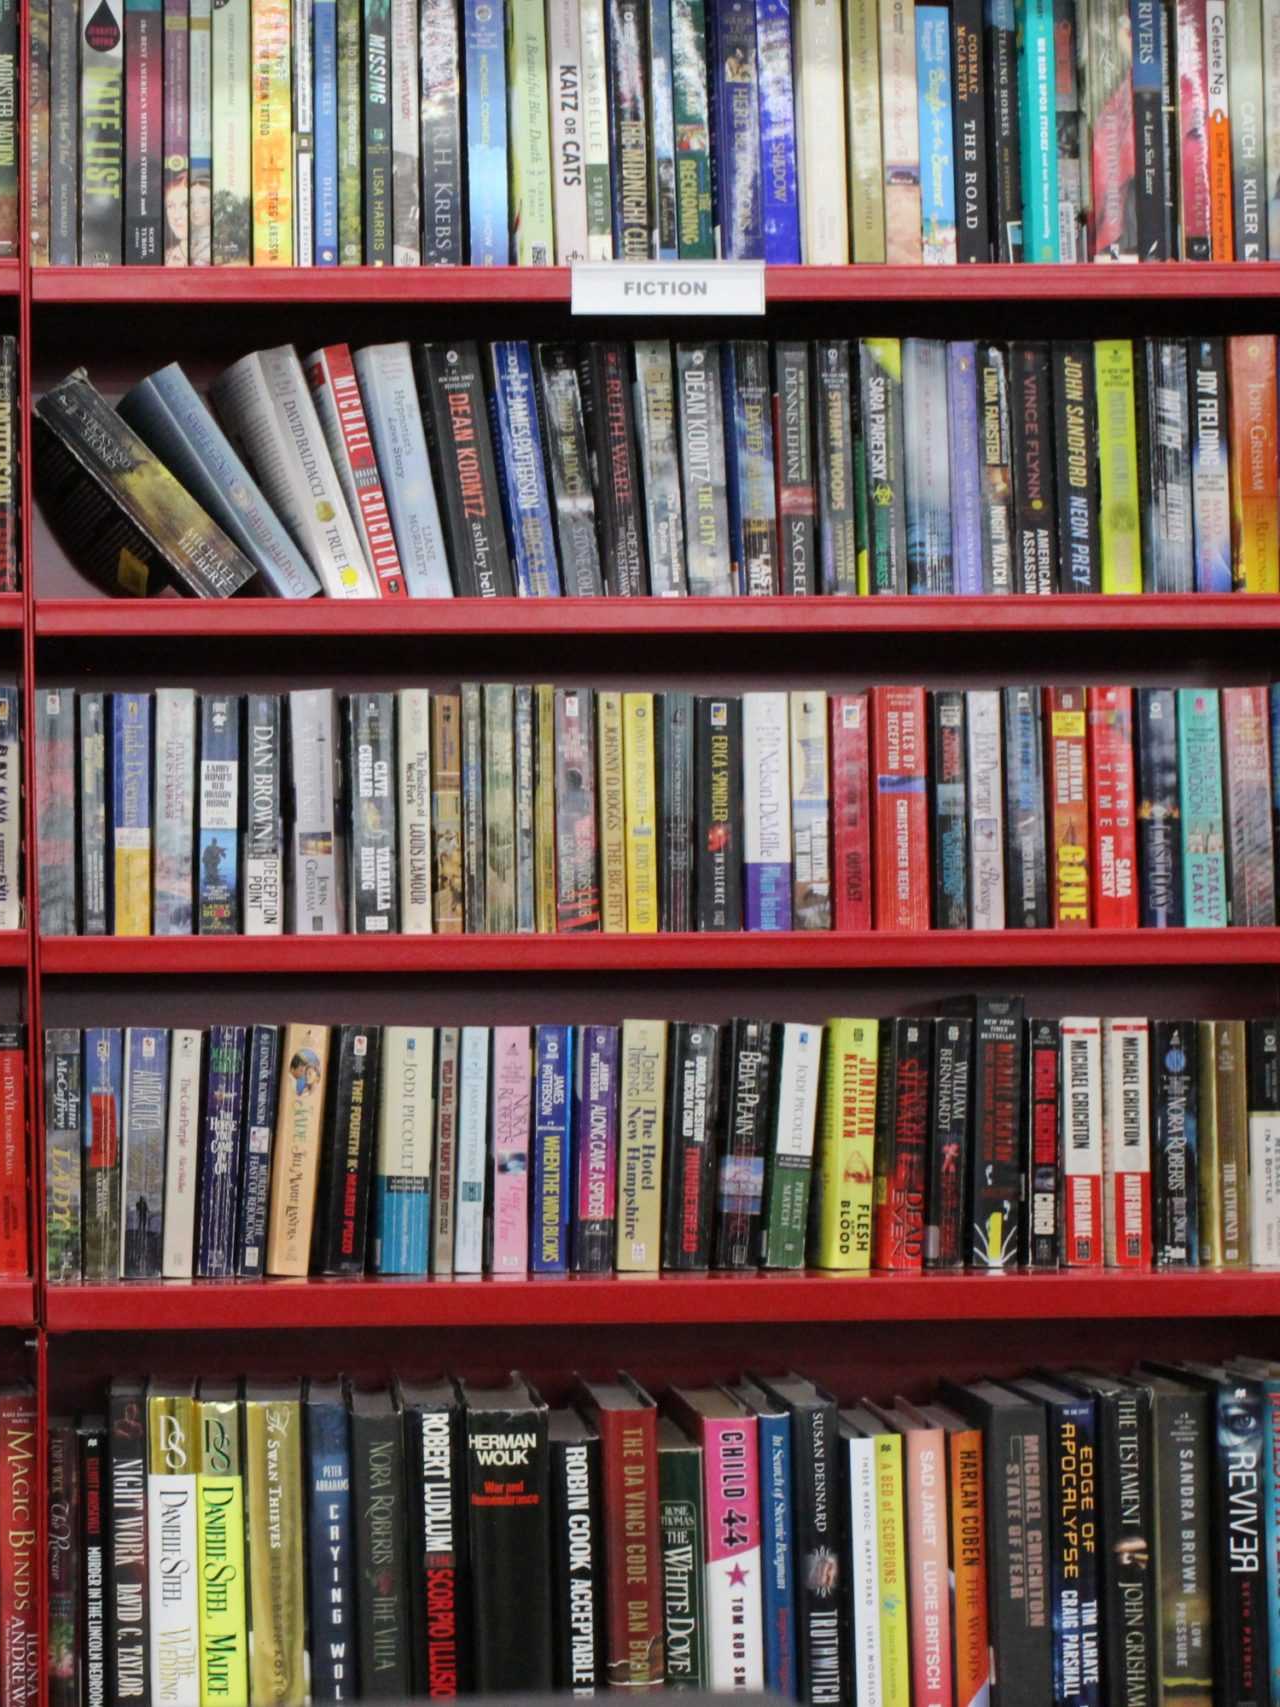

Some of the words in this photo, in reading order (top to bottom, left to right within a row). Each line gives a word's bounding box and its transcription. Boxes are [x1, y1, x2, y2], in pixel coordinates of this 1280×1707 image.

[1139, 2, 1154, 64] RIVERS
[1212, 16, 1223, 69] Celeste
[369, 33, 386, 104] MISSING
[561, 65, 579, 111] KATZ
[957, 26, 967, 102] McCARTHY
[968, 34, 978, 93] CORMAC
[1210, 73, 1224, 95] Ng
[564, 118, 576, 134] OR
[964, 120, 976, 161] THE
[373, 168, 384, 195] LISA
[563, 141, 581, 186] CATS
[374, 200, 384, 250] HARRIS
[965, 172, 978, 229] ROAD
[1244, 179, 1258, 234] KILLER
[624, 281, 708, 296] FICTION
[1064, 357, 1083, 400] JOHN
[1196, 370, 1217, 394] JOY
[448, 393, 471, 441] DEAN
[1198, 399, 1219, 466] FIELDING
[1067, 405, 1087, 487] SANDFORD
[335, 376, 372, 451] MICHAEL
[361, 492, 401, 578] CRICHTON
[458, 448, 486, 519] KOONTZ
[1070, 496, 1088, 538] NEON
[471, 522, 488, 568] ashley
[1023, 530, 1036, 594] ASSASSIN
[1036, 529, 1050, 595] AMERICAN
[1073, 544, 1090, 585] PREY
[479, 572, 495, 597] bell
[253, 725, 273, 766] DAN
[358, 744, 372, 797] CUSSLER
[712, 736, 728, 767] ERICA
[374, 761, 387, 797] CLIVE
[712, 771, 729, 821] SPINDLER
[253, 774, 272, 840] BROWN
[410, 824, 425, 856] LOUIS
[249, 875, 262, 910] POINT
[264, 861, 277, 924] DECEPTION
[361, 847, 375, 890] RISING
[376, 847, 390, 910] VALHALLA
[1059, 846, 1087, 920] GONE
[1192, 864, 1204, 913] FLAKY
[1207, 857, 1220, 921] FATALLY
[1122, 1038, 1138, 1085] MICHAEL
[642, 1106, 657, 1138] The
[843, 1054, 857, 1138] KELLERMAN
[858, 1058, 875, 1136] JONATHAN
[1123, 1090, 1140, 1146] CRICHTON
[626, 1106, 640, 1143] New
[624, 1147, 641, 1239] Hampshire
[641, 1144, 657, 1190] Hotel
[839, 1200, 851, 1254] BLOOD
[856, 1204, 870, 1251] FLESH
[422, 1413, 450, 1478] ROBERT
[469, 1433, 537, 1448] HERMAN
[477, 1451, 529, 1466] WOUK
[721, 1432, 745, 1499] CHILD
[7, 1429, 34, 1521] MAGIC
[565, 1446, 589, 1510] ROBIN
[1061, 1423, 1078, 1579] APOCALYPSE
[1080, 1446, 1094, 1510] EDGE
[202, 1487, 234, 1560] DANIELLE
[424, 1482, 452, 1552] LUDLUM
[569, 1515, 591, 1571] COOK
[723, 1509, 748, 1548] 44
[1081, 1523, 1094, 1553] OF
[8, 1529, 35, 1611] BINDS
[205, 1562, 237, 1618] STEEL
[664, 1544, 693, 1613] WHITE
[205, 1634, 237, 1696] MALICE
[667, 1618, 694, 1674] DOVE
